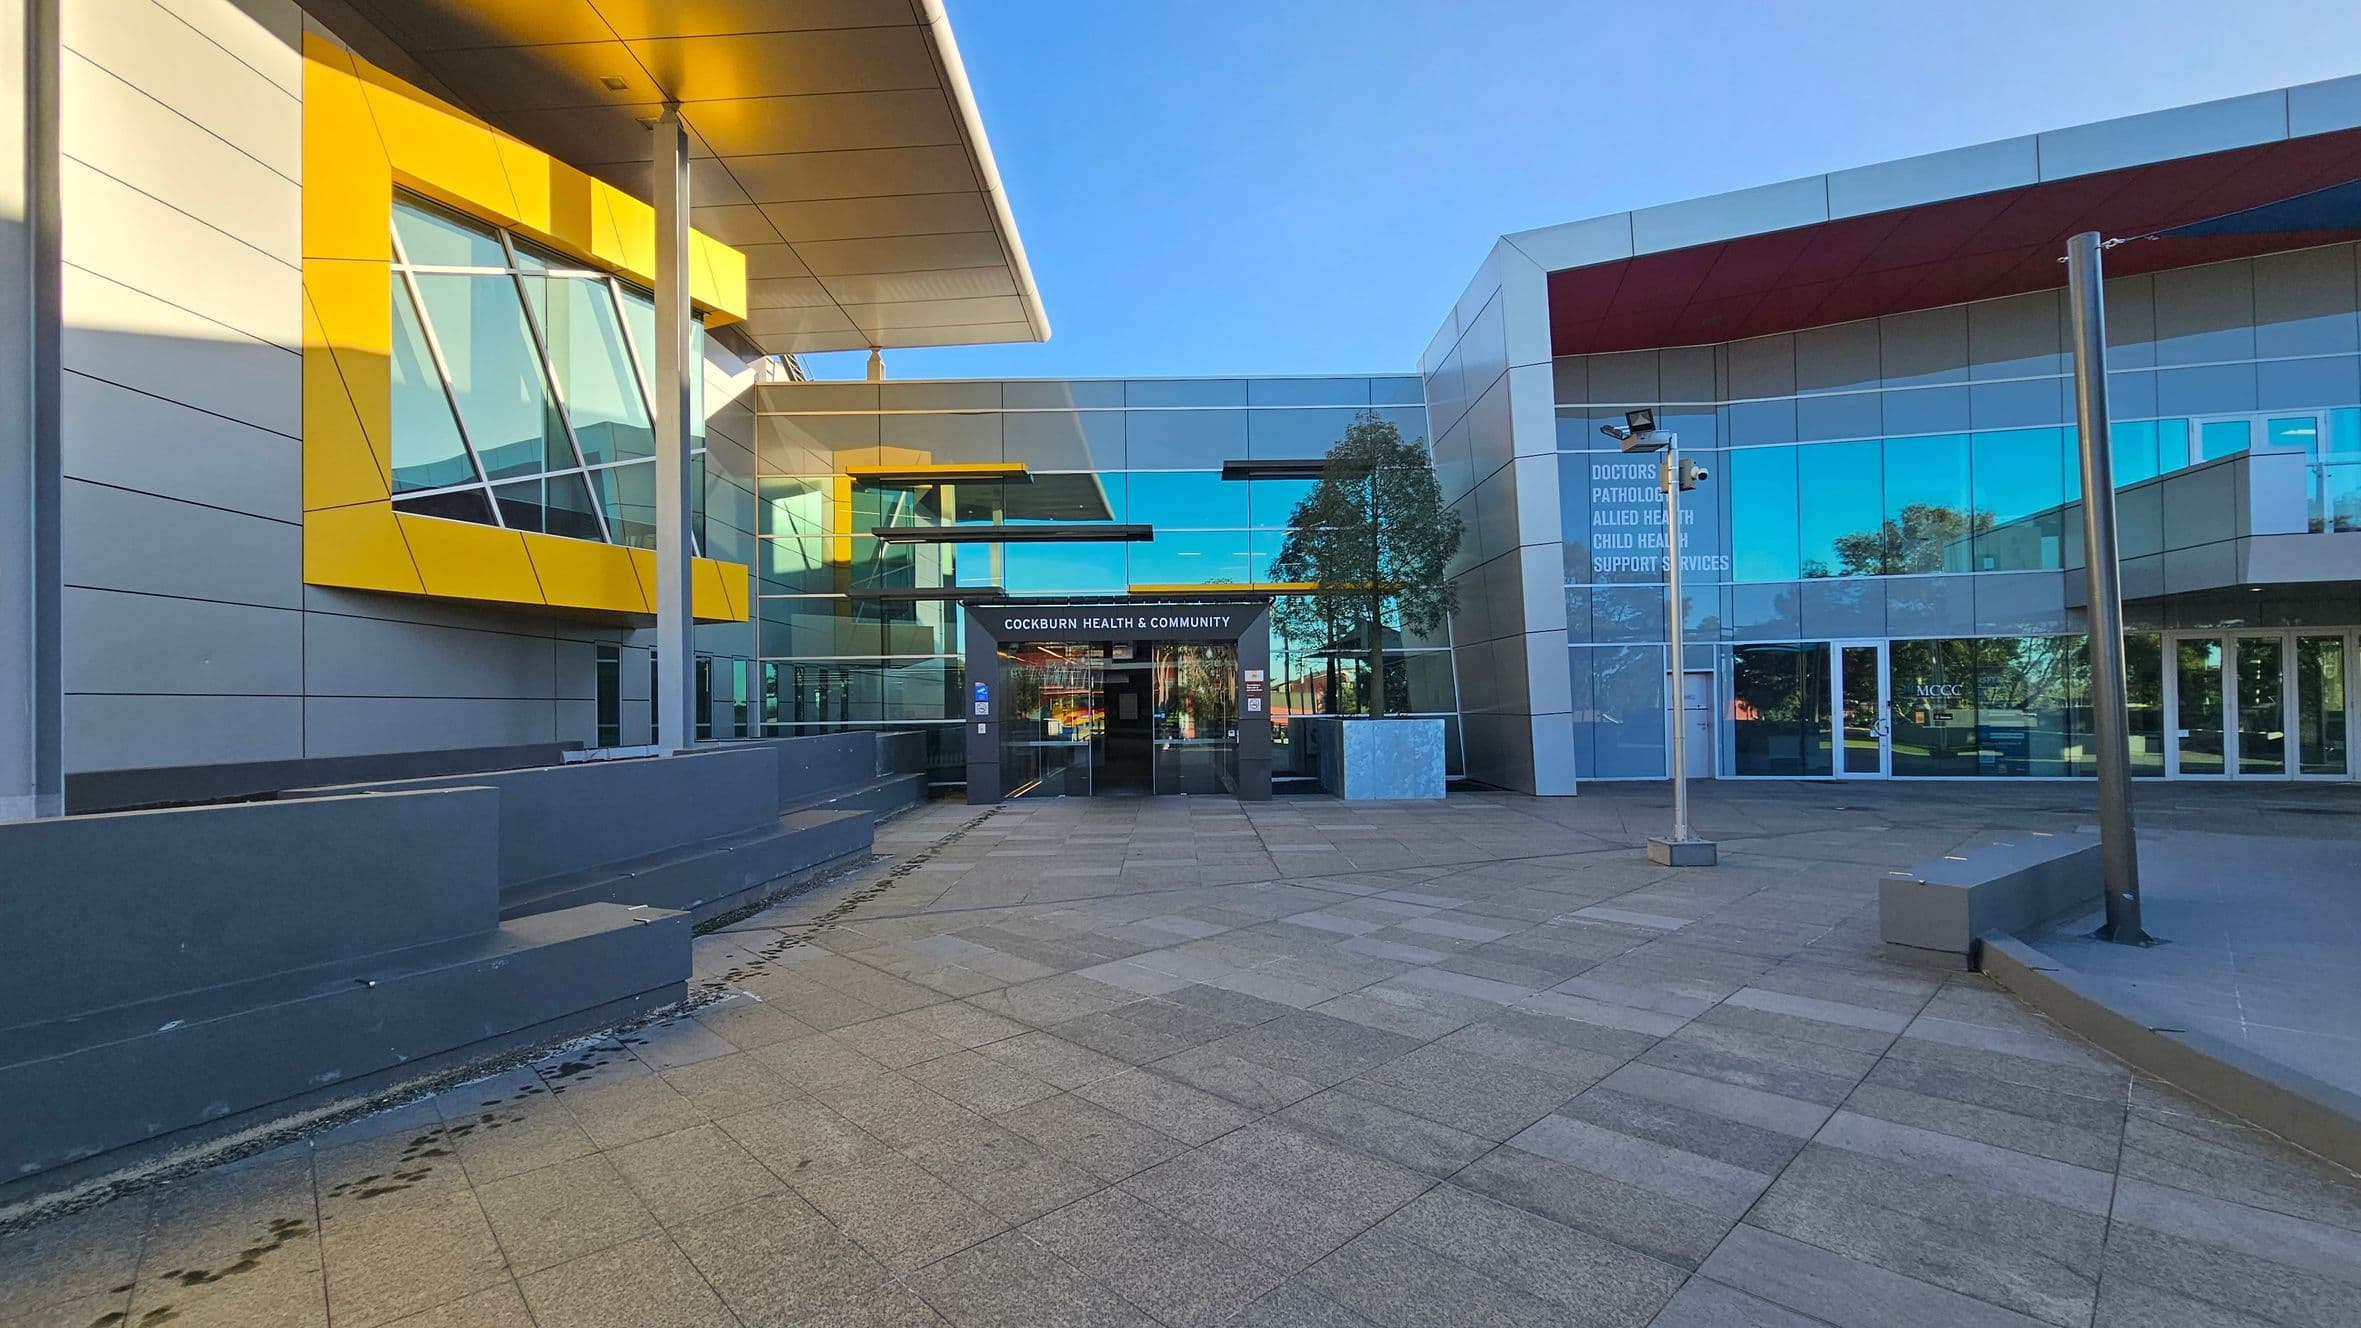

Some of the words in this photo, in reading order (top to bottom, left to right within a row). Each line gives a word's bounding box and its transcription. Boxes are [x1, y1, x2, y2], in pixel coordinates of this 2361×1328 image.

[1592, 464, 1656, 480] DOCTORS
[1592, 486, 1669, 503] PATHOLOG
[1593, 510, 1639, 526] ALLIED
[1643, 509, 1694, 525] HEATH
[1593, 533, 1633, 549] CHILD
[1638, 532, 1689, 548] HEALH
[1593, 556, 1658, 572] SUPPORT
[1662, 555, 1729, 571] SRVICES
[1004, 618, 1077, 630] COCKBURN
[1083, 617, 1134, 629] HEALTH
[1138, 617, 1146, 629] &
[1150, 616, 1231, 628] COMMUNITY
[1916, 684, 1963, 697] MCCC
